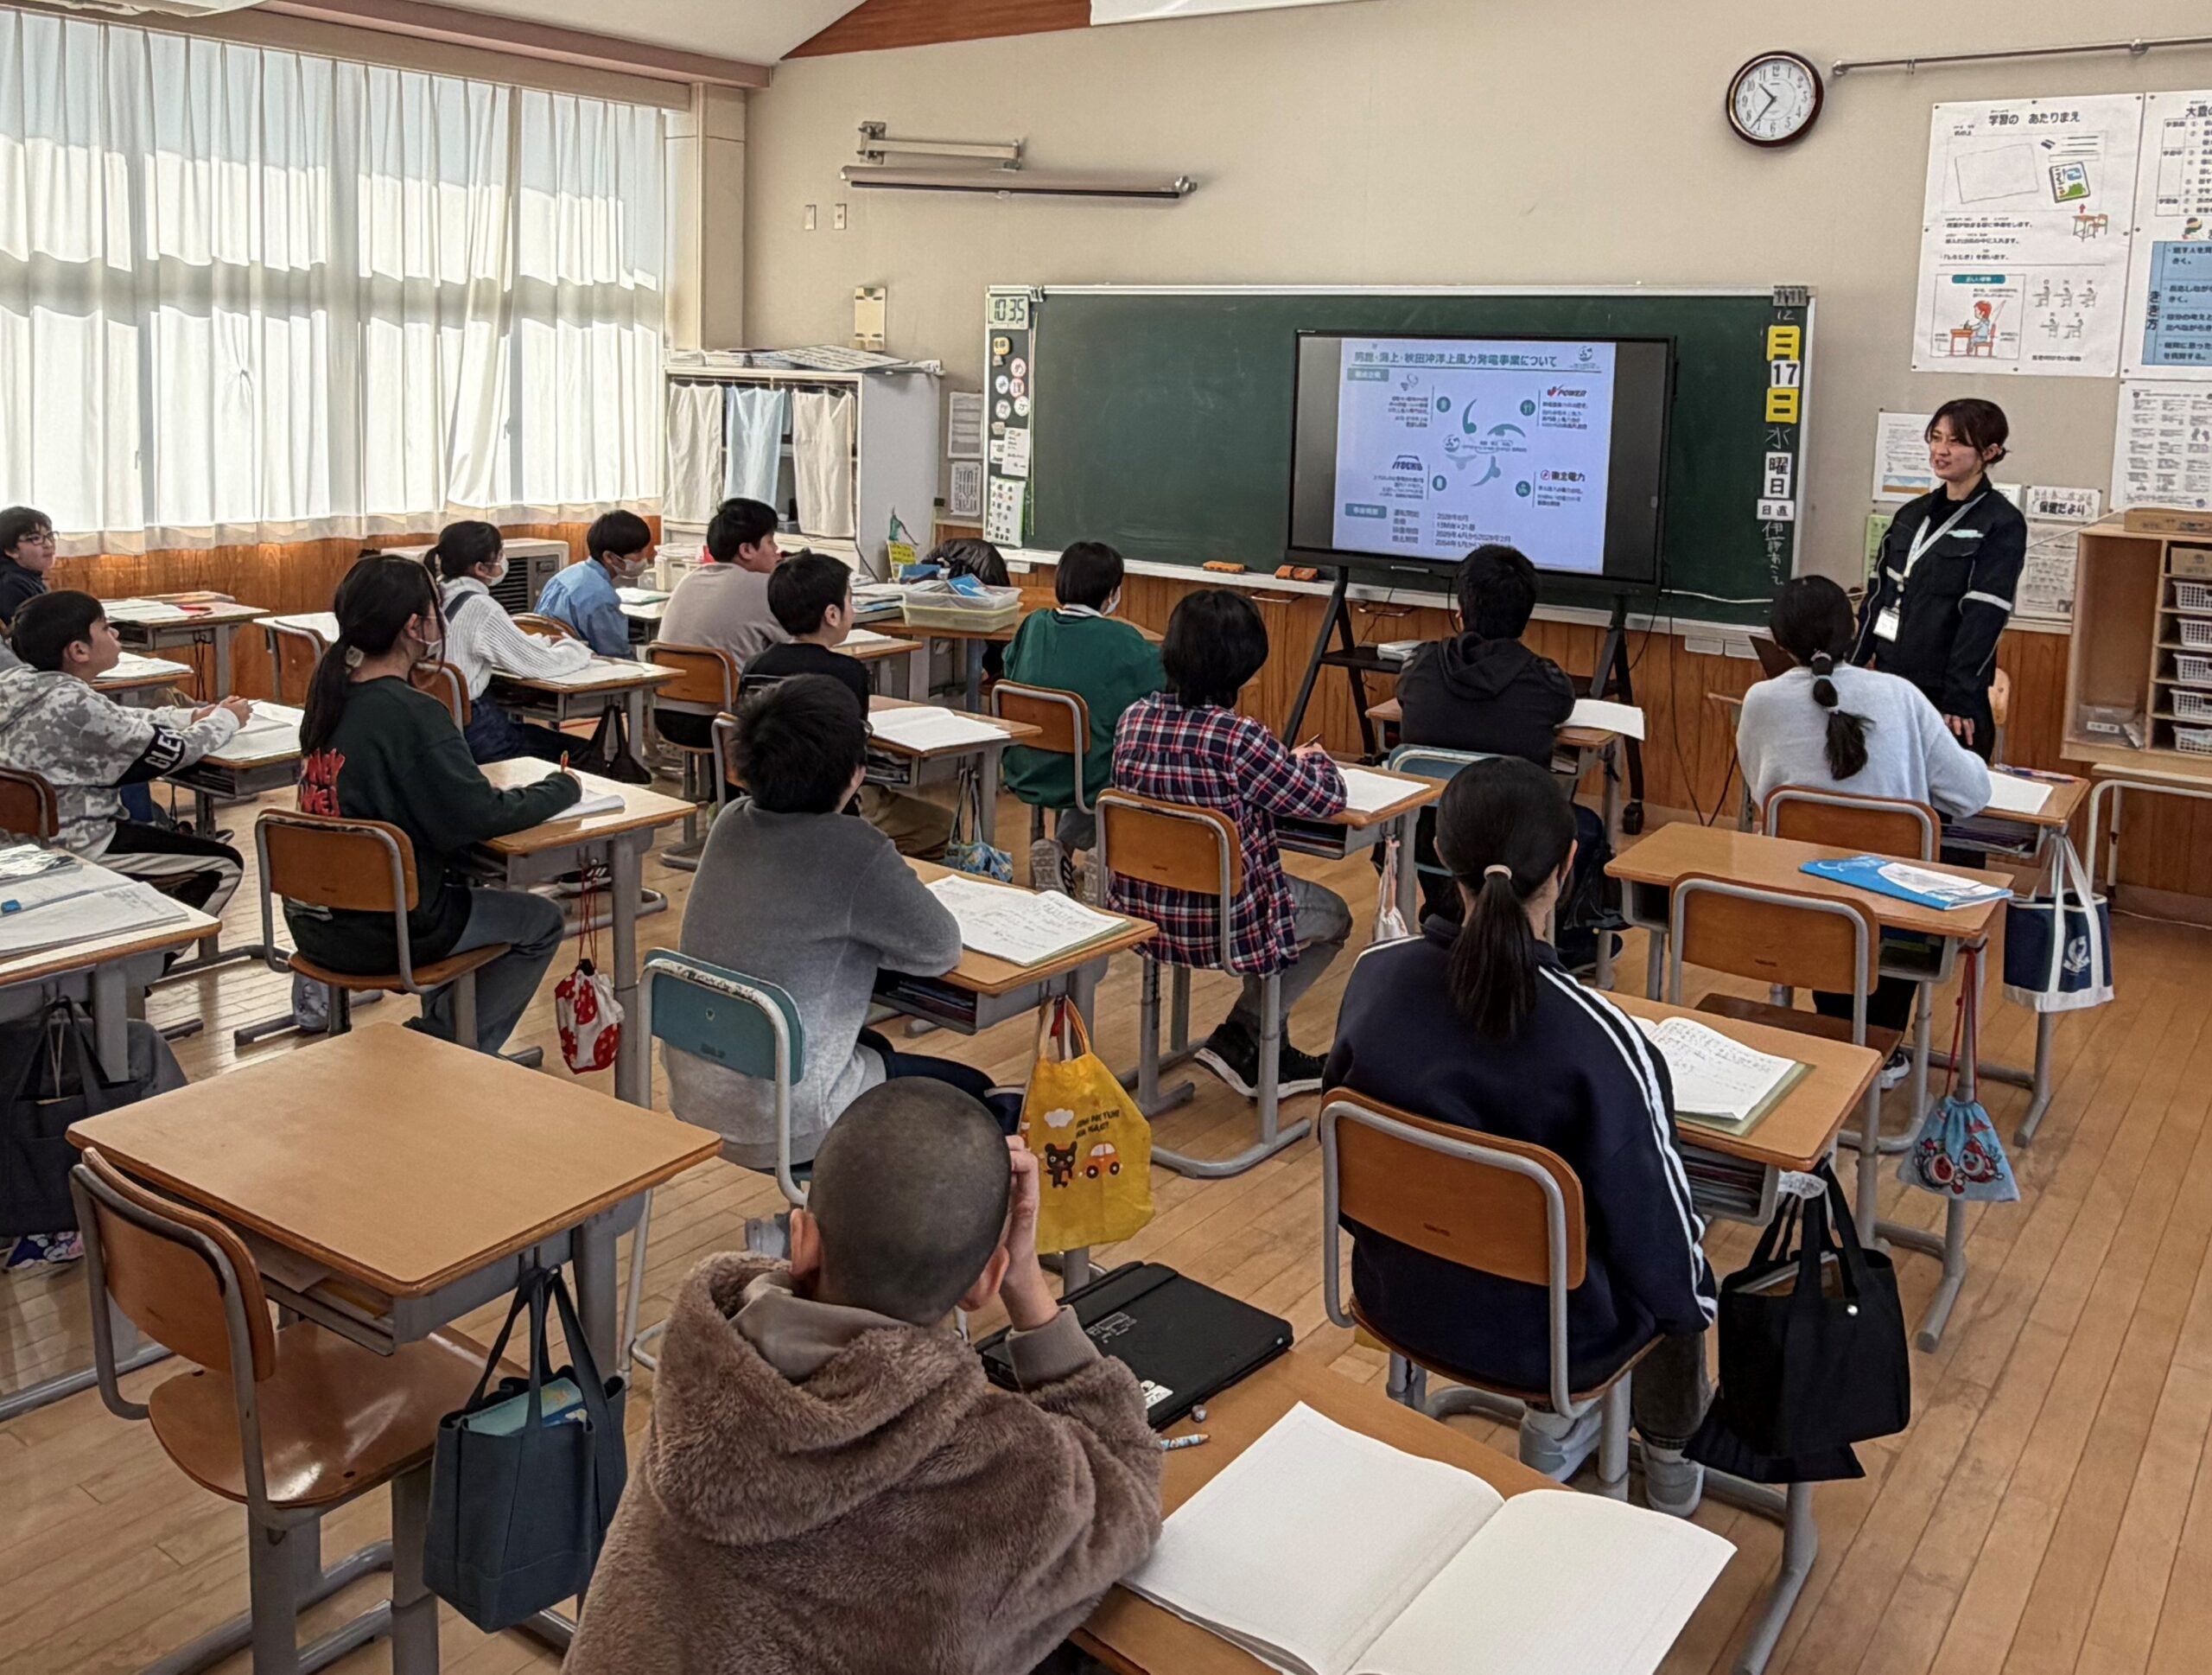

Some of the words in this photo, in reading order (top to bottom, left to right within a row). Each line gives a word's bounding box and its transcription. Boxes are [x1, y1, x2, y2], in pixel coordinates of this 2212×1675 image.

[1989, 113, 2019, 126] 学習の
[2028, 111, 2080, 124] あたりまえ
[1773, 364, 1798, 385] 17
[1764, 427, 1790, 449] 水
[1769, 456, 1789, 494] 曜日
[1762, 505, 1789, 516] 日直
